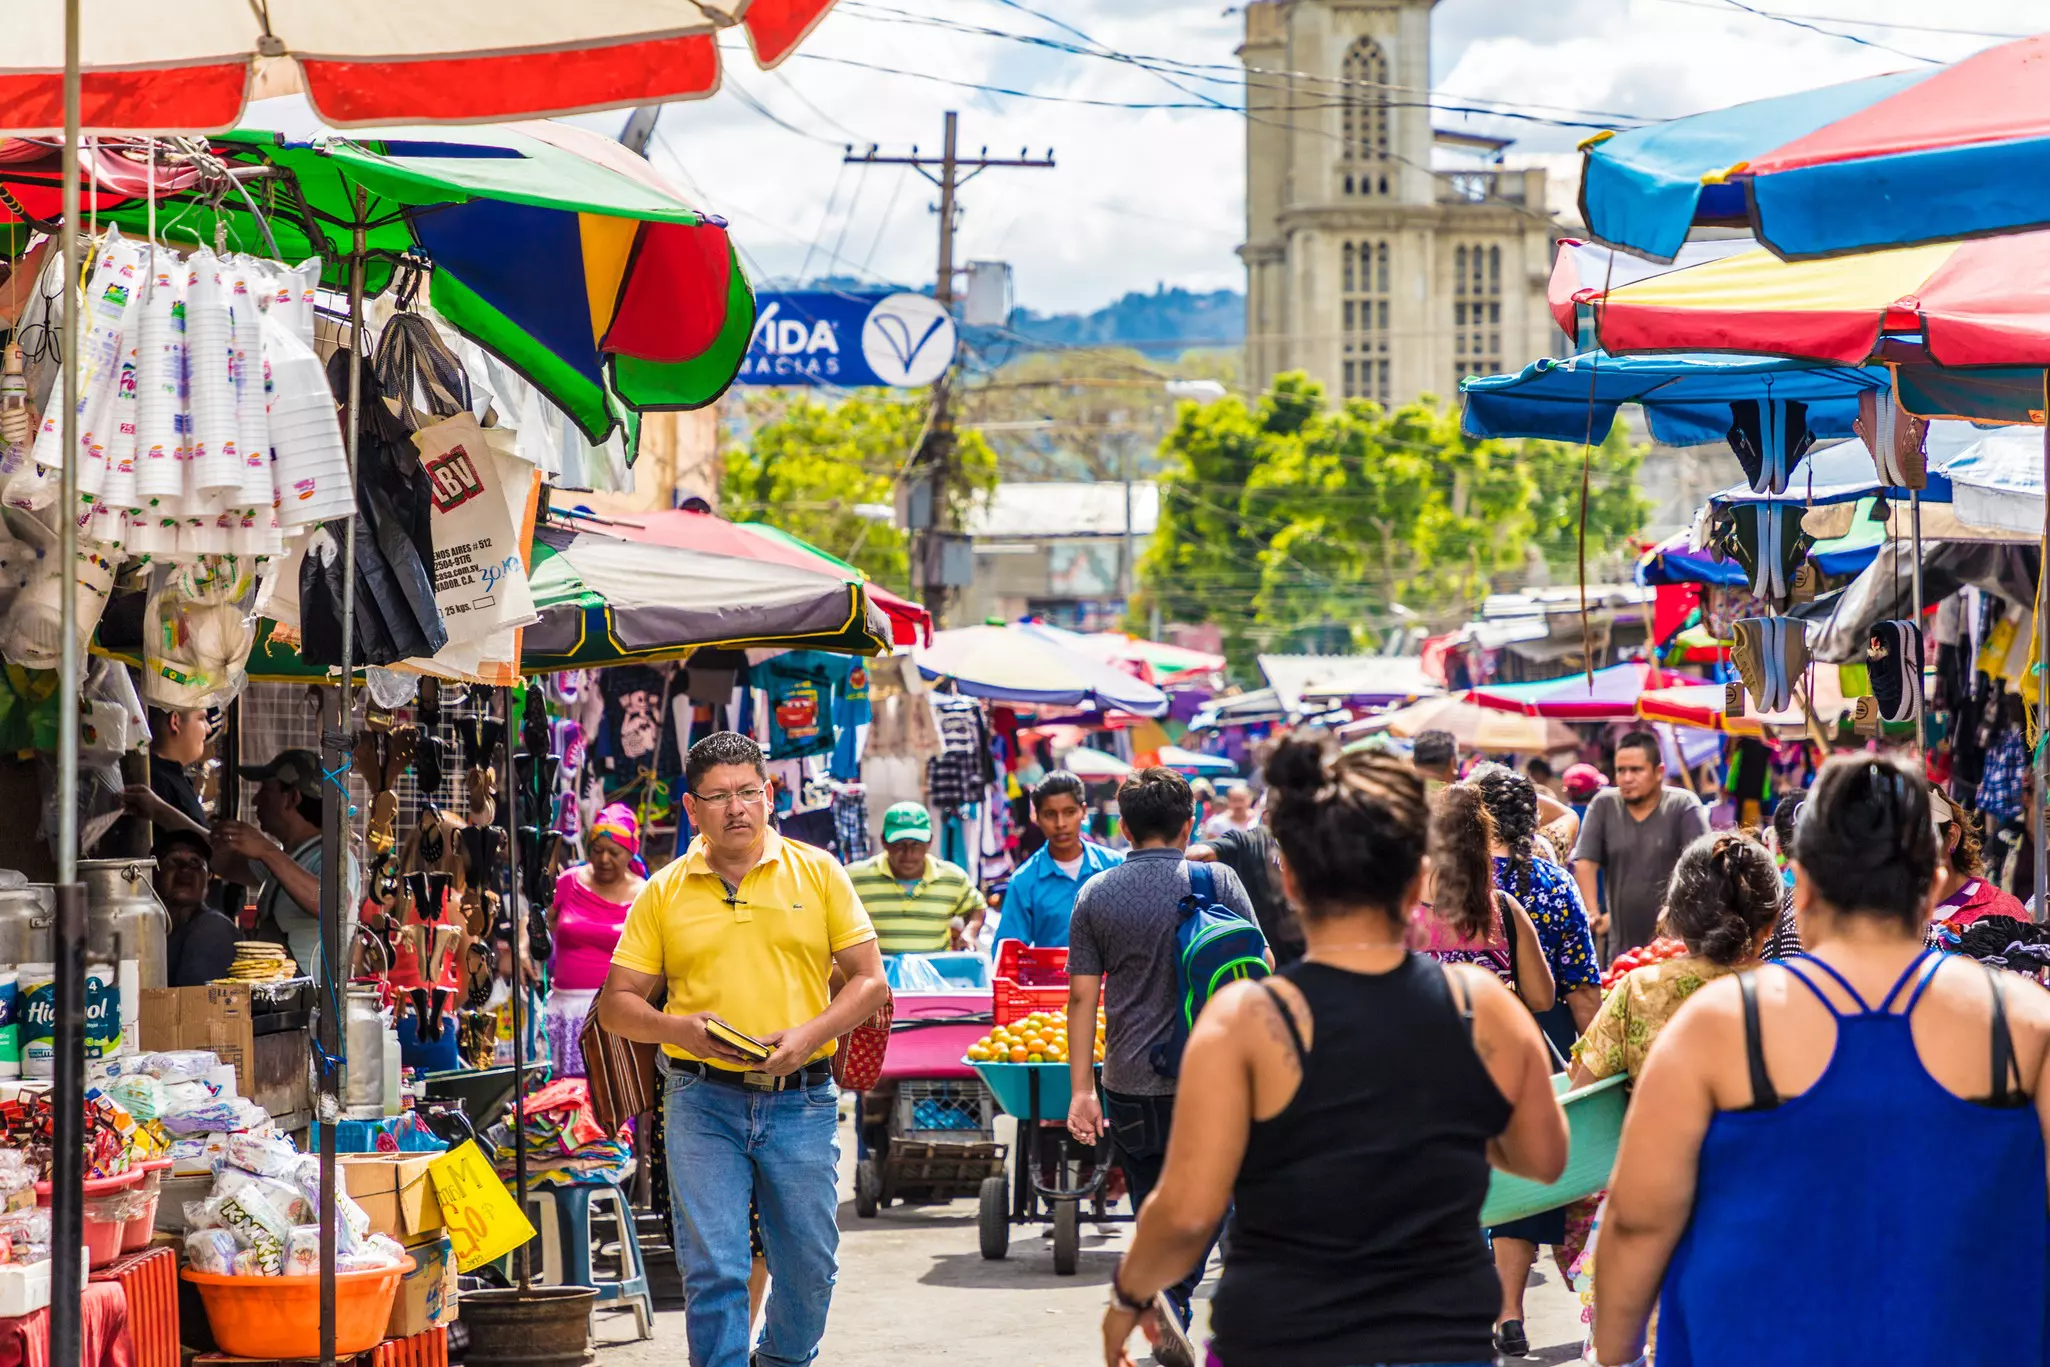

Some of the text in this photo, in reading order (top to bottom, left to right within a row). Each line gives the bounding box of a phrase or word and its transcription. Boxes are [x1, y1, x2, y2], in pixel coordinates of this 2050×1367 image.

[451, 544, 472, 554] AIRES
[444, 606, 456, 616] 25
[88, 981, 97, 991] 4
